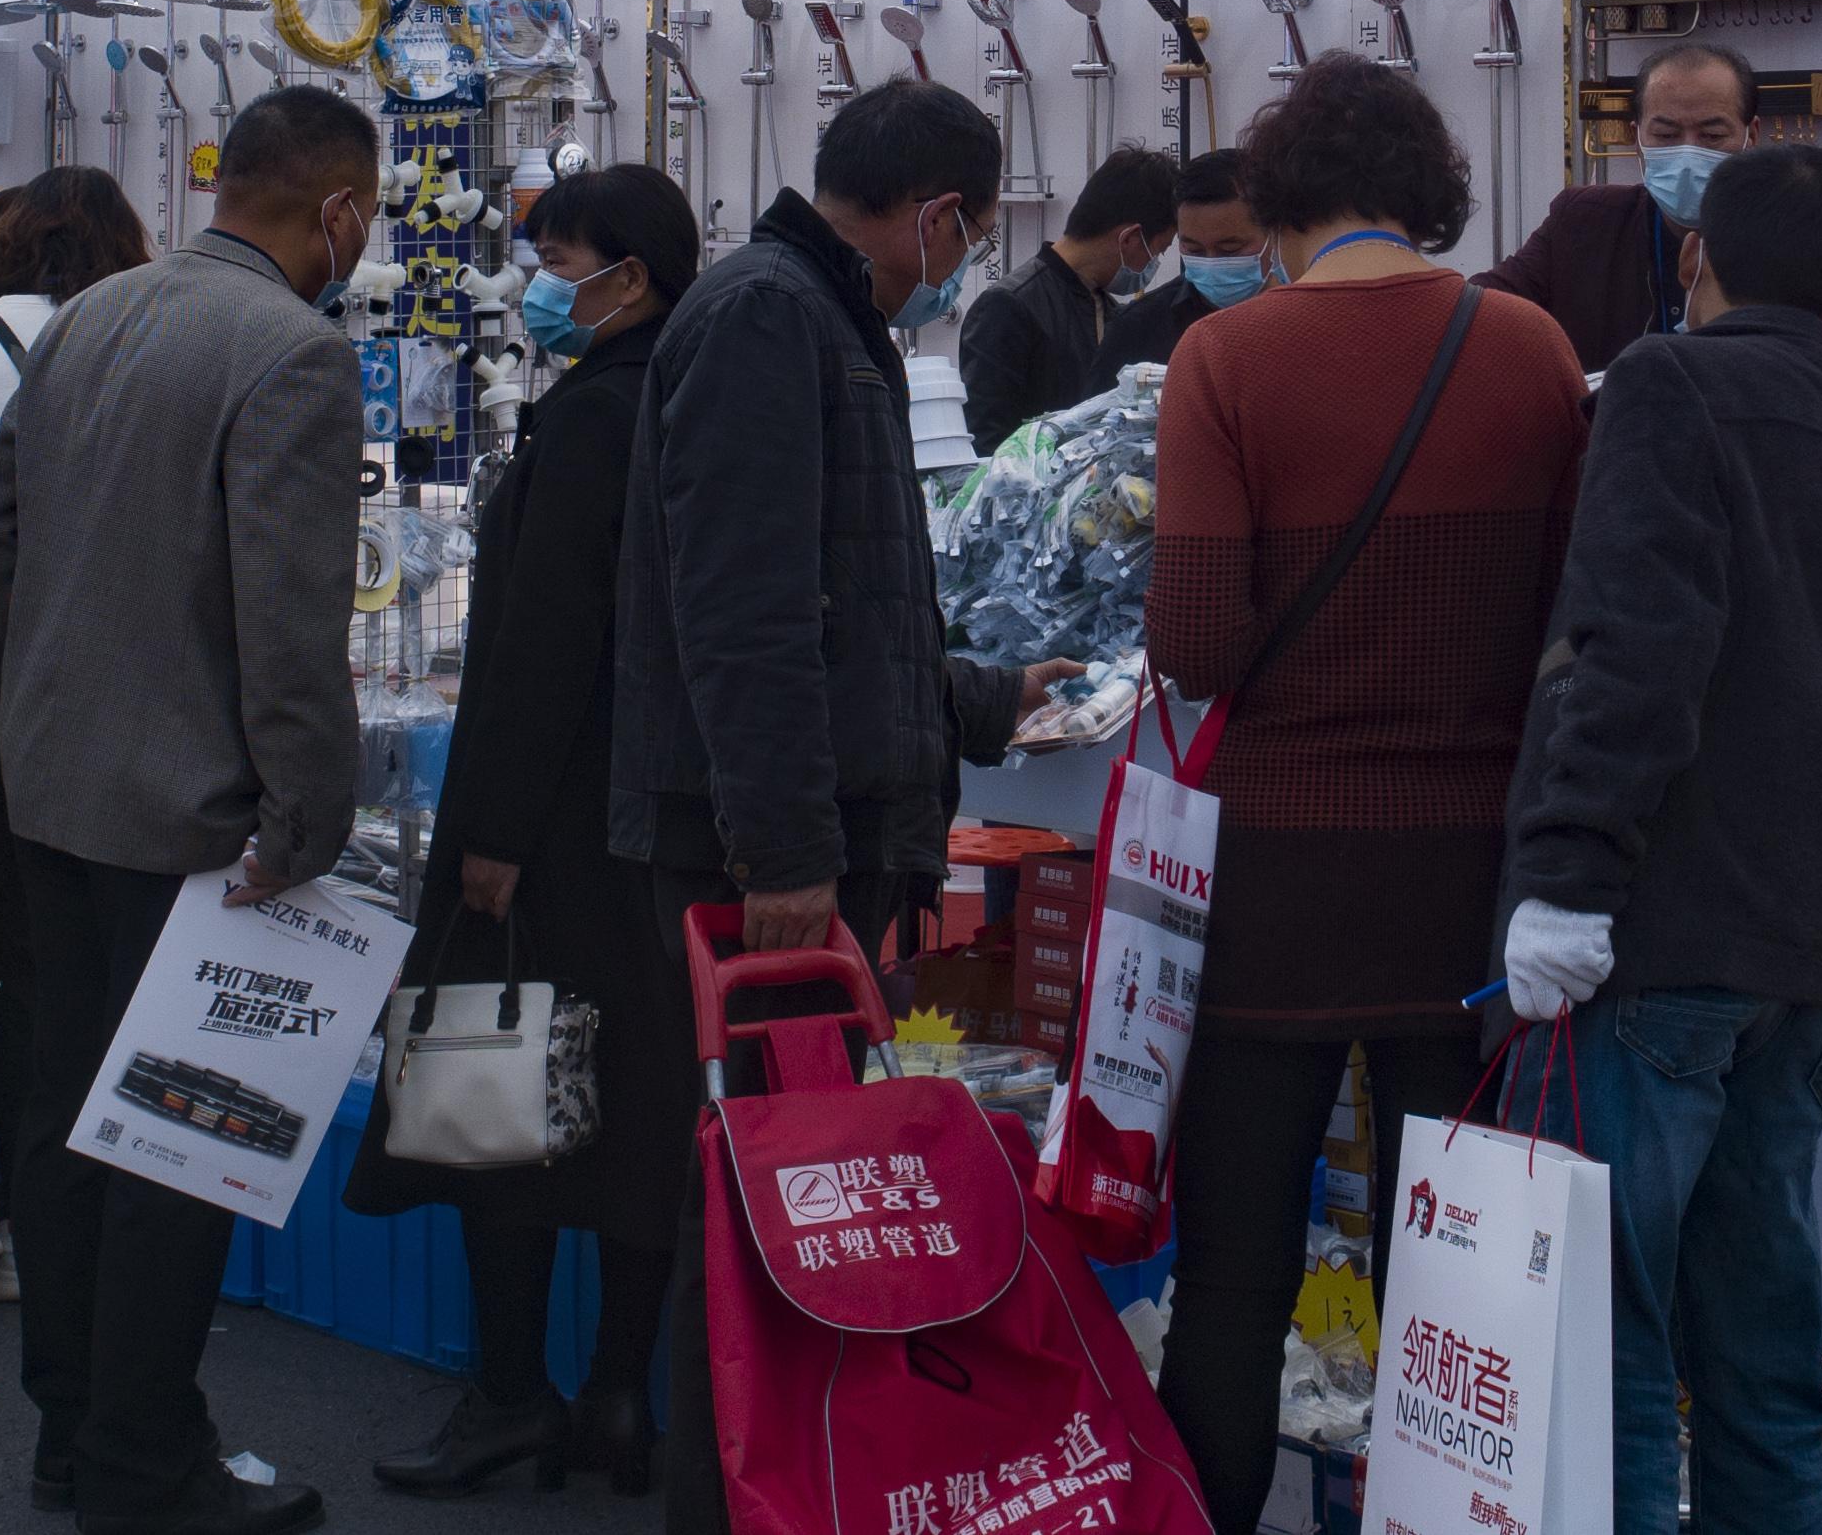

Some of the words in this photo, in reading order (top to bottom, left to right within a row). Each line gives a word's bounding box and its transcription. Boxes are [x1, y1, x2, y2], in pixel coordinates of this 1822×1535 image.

[194, 958, 315, 1006] 我们掌握
[206, 990, 337, 1038] 旋流式
[836, 1153, 933, 1191] 联塑
[1444, 1203, 1479, 1227] DELIXI
[794, 1222, 962, 1273] 联塑管道
[1402, 1312, 1512, 1427] 领航者
[1395, 1388, 1514, 1476] NAVIGATOR
[1506, 1388, 1520, 1432] 系列
[883, 1410, 1109, 1535] 联塑管道
